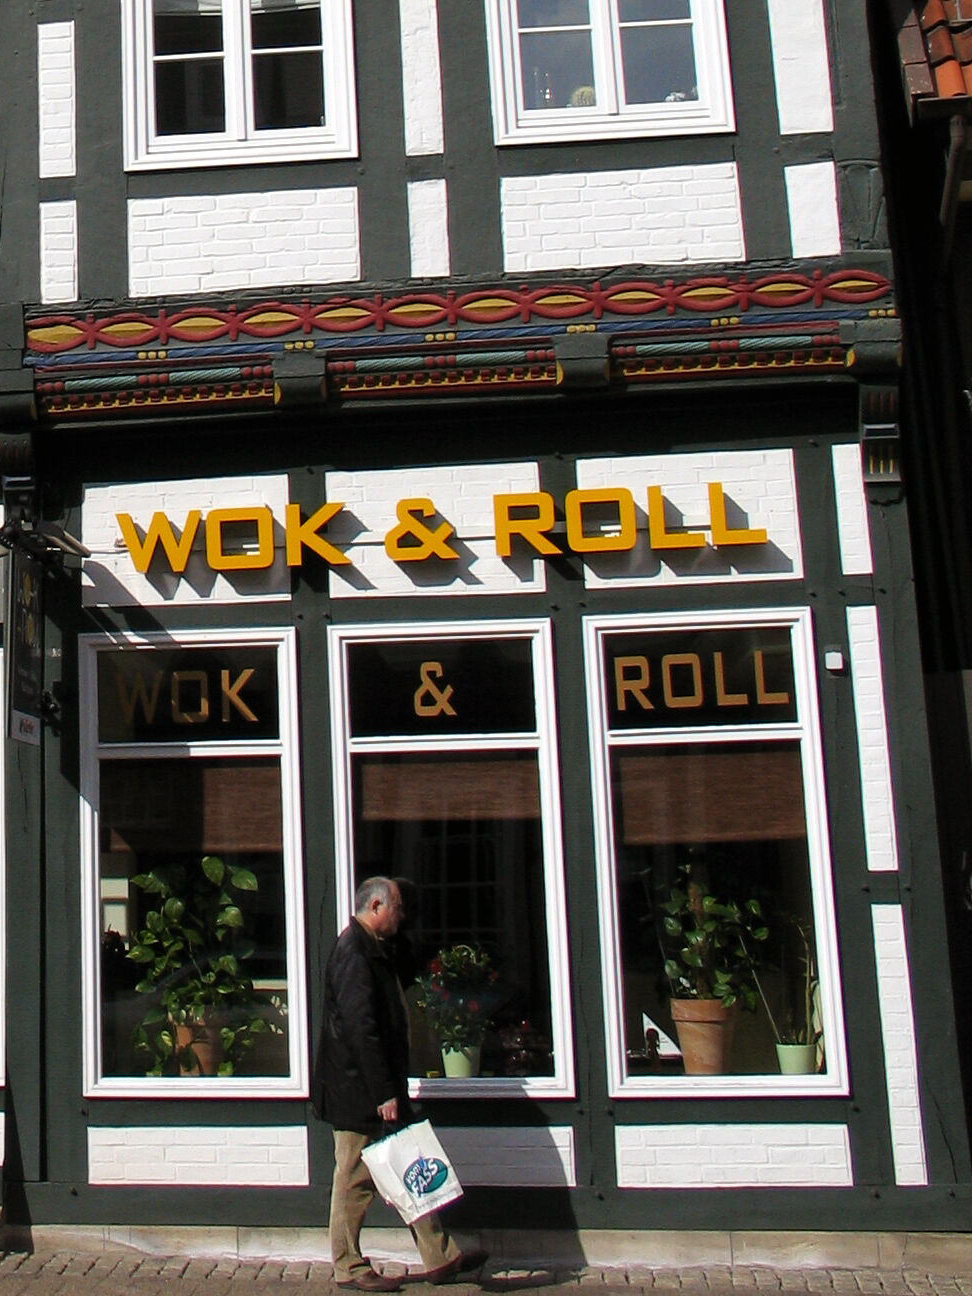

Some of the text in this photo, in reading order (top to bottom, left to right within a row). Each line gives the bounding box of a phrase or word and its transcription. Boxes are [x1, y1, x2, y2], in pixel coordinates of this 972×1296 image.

[116, 482, 768, 574] WOK & ROLL
[119, 650, 790, 724] WOK & ROLL
